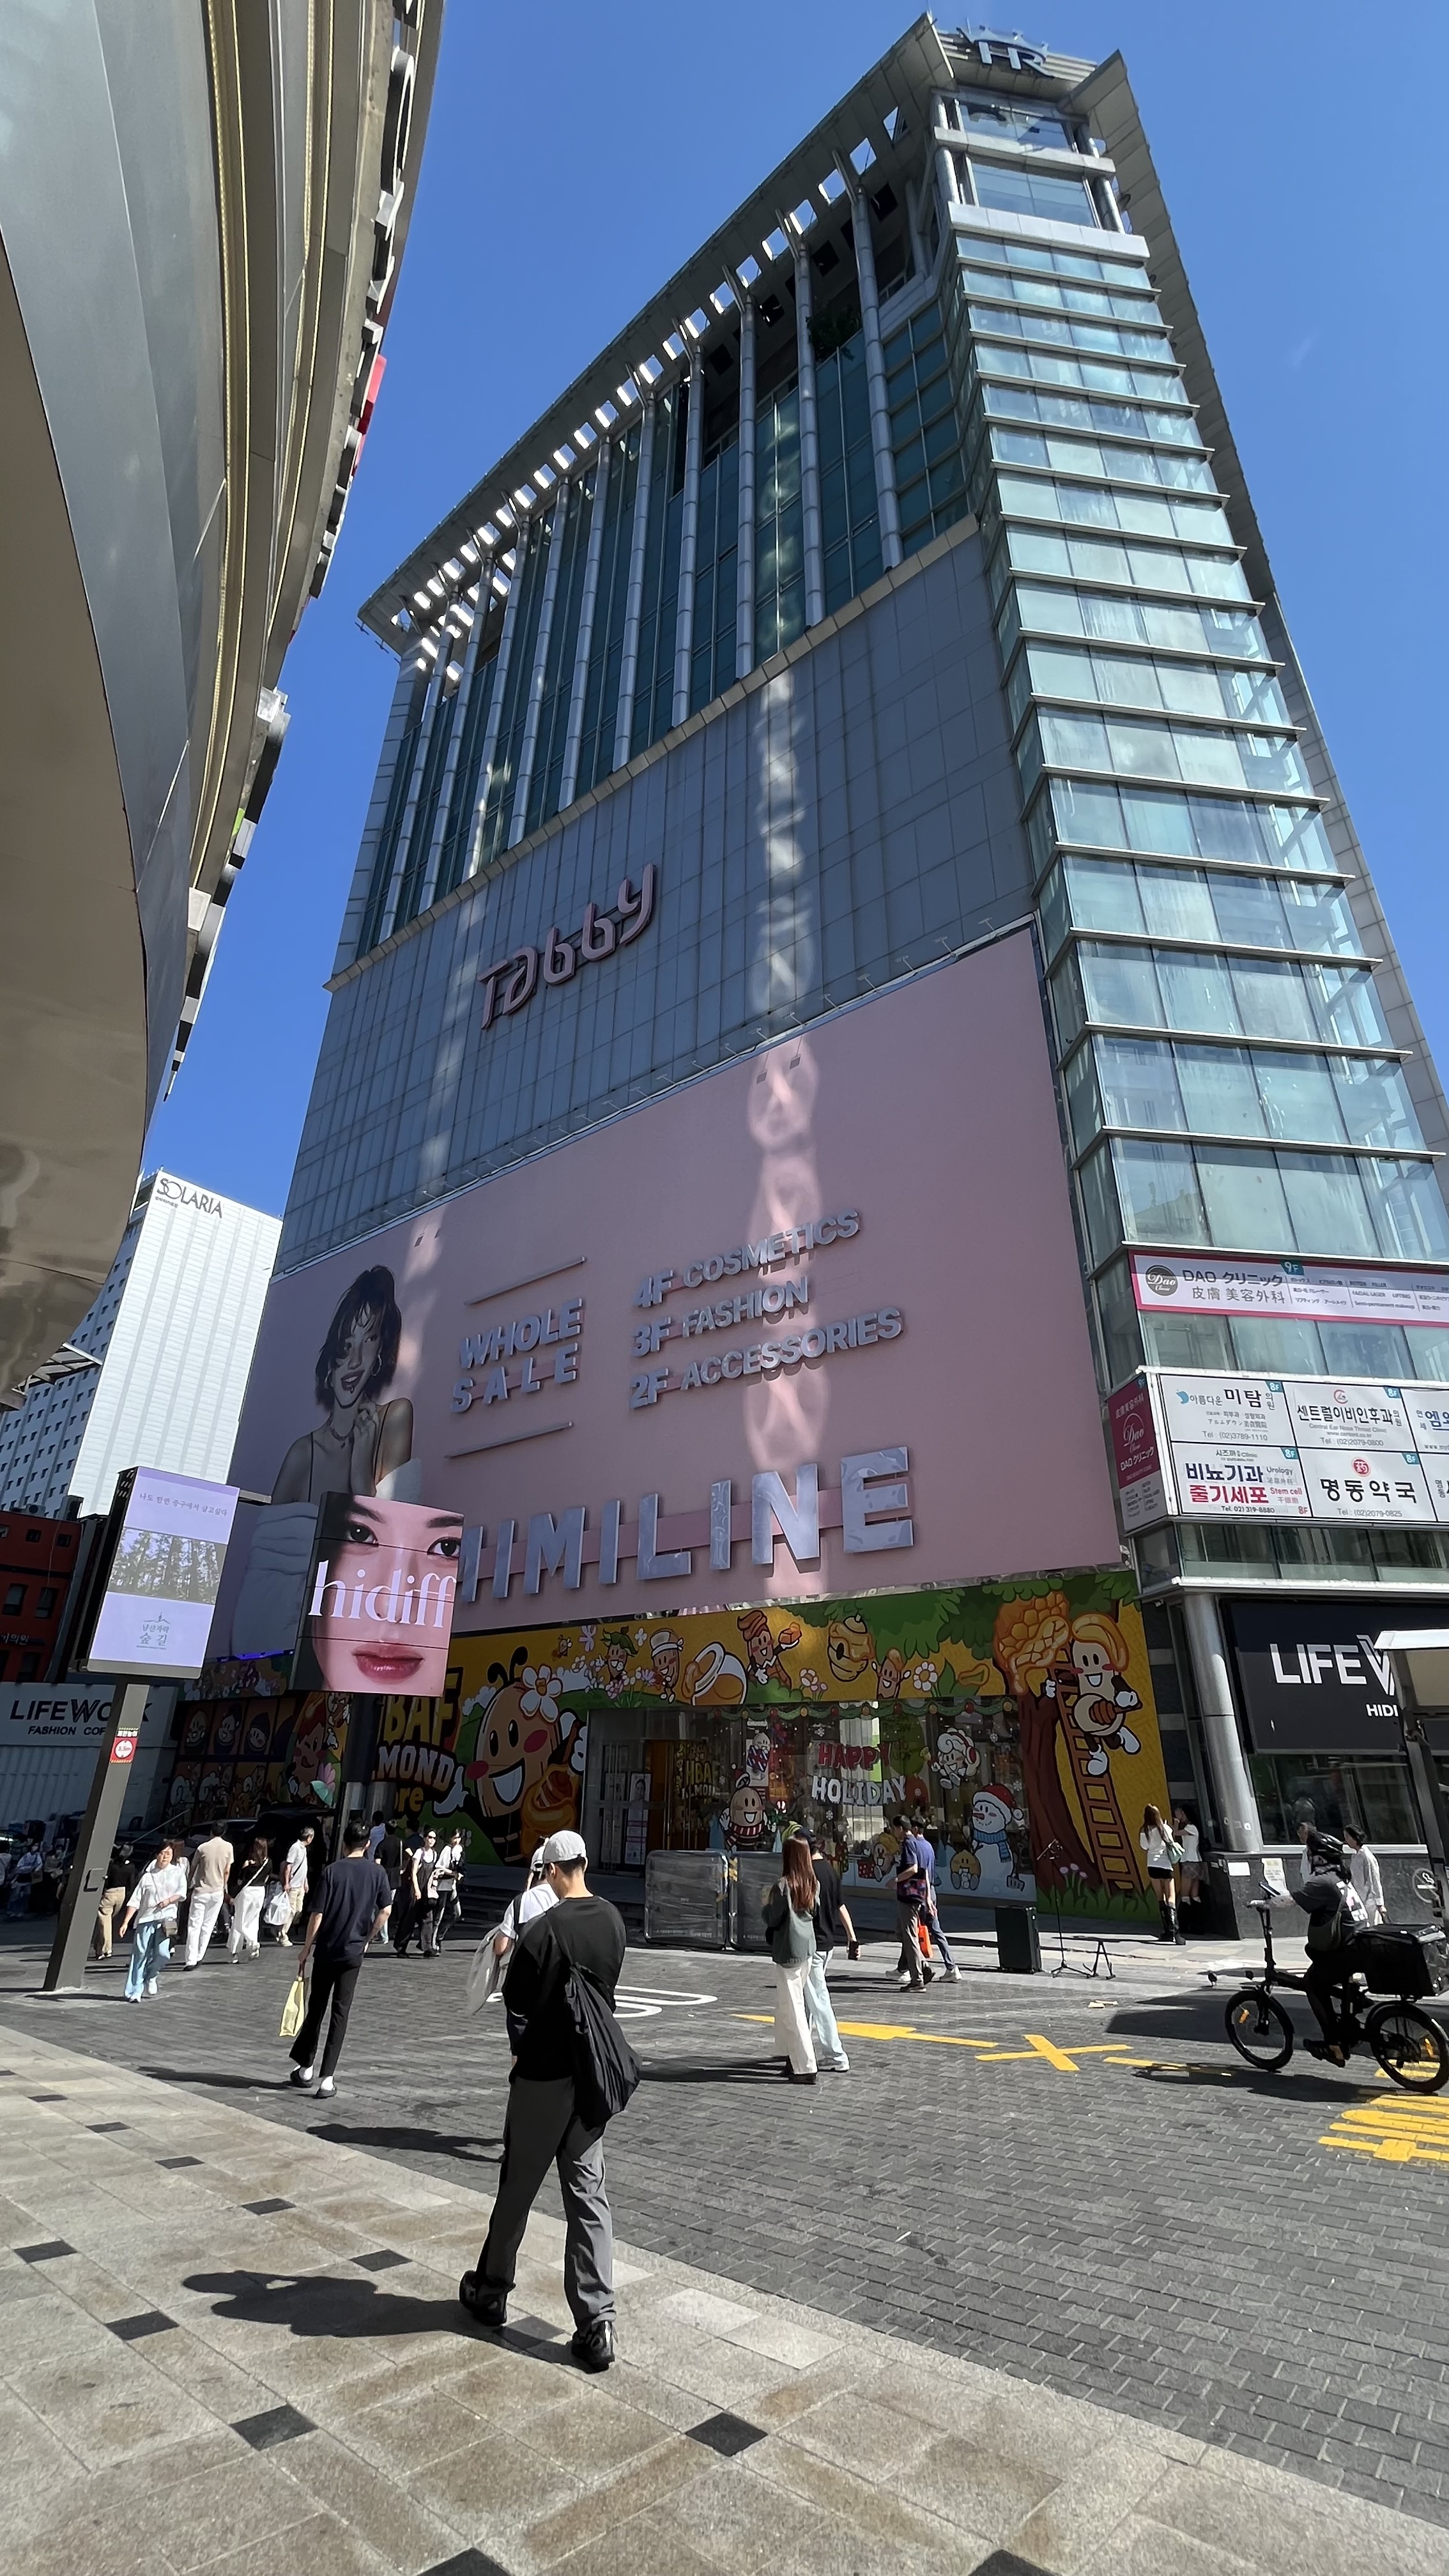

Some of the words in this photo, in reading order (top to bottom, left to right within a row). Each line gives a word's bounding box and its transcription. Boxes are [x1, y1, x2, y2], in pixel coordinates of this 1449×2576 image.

[157, 1178, 222, 1218] SOLARIA
[633, 1269, 674, 1308] 4F
[684, 1209, 860, 1288] COSMETICS
[1284, 1261, 1299, 1273] 9F
[1182, 1269, 1216, 1283] DAO
[1222, 1271, 1283, 1287] クリニック
[1226, 1287, 1285, 1304] 美容外科
[632, 1317, 671, 1357] 3F
[682, 1276, 808, 1338] FASHION
[460, 1298, 583, 1368] WHOLE
[629, 1368, 669, 1409] 2F
[680, 1307, 902, 1391] ACCESSORIES
[450, 1342, 578, 1413] SALE
[1269, 1383, 1280, 1391] 8F
[1190, 1395, 1223, 1406] 아름다운
[1388, 1388, 1398, 1397] 8F
[1297, 1405, 1393, 1425] 센트럴이비인후과
[1285, 1448, 1295, 1458] 8F
[1406, 1454, 1416, 1463] 8F
[1185, 1462, 1263, 1483] 비뇨기과
[1266, 1466, 1293, 1476] Urology
[1190, 1484, 1269, 1504] 줄기세포
[1320, 1478, 1417, 1504] 명동약국
[1298, 1506, 1308, 1514] 8F
[308, 1560, 457, 1628] hidiff
[1269, 1634, 1395, 1696] LIFEW
[383, 1673, 458, 1746] BAF
[27, 1725, 77, 1735] FASHION
[818, 1742, 892, 1771] HAPPY
[372, 1745, 455, 1792] MOND
[811, 1775, 907, 1807] HOLIDAY
